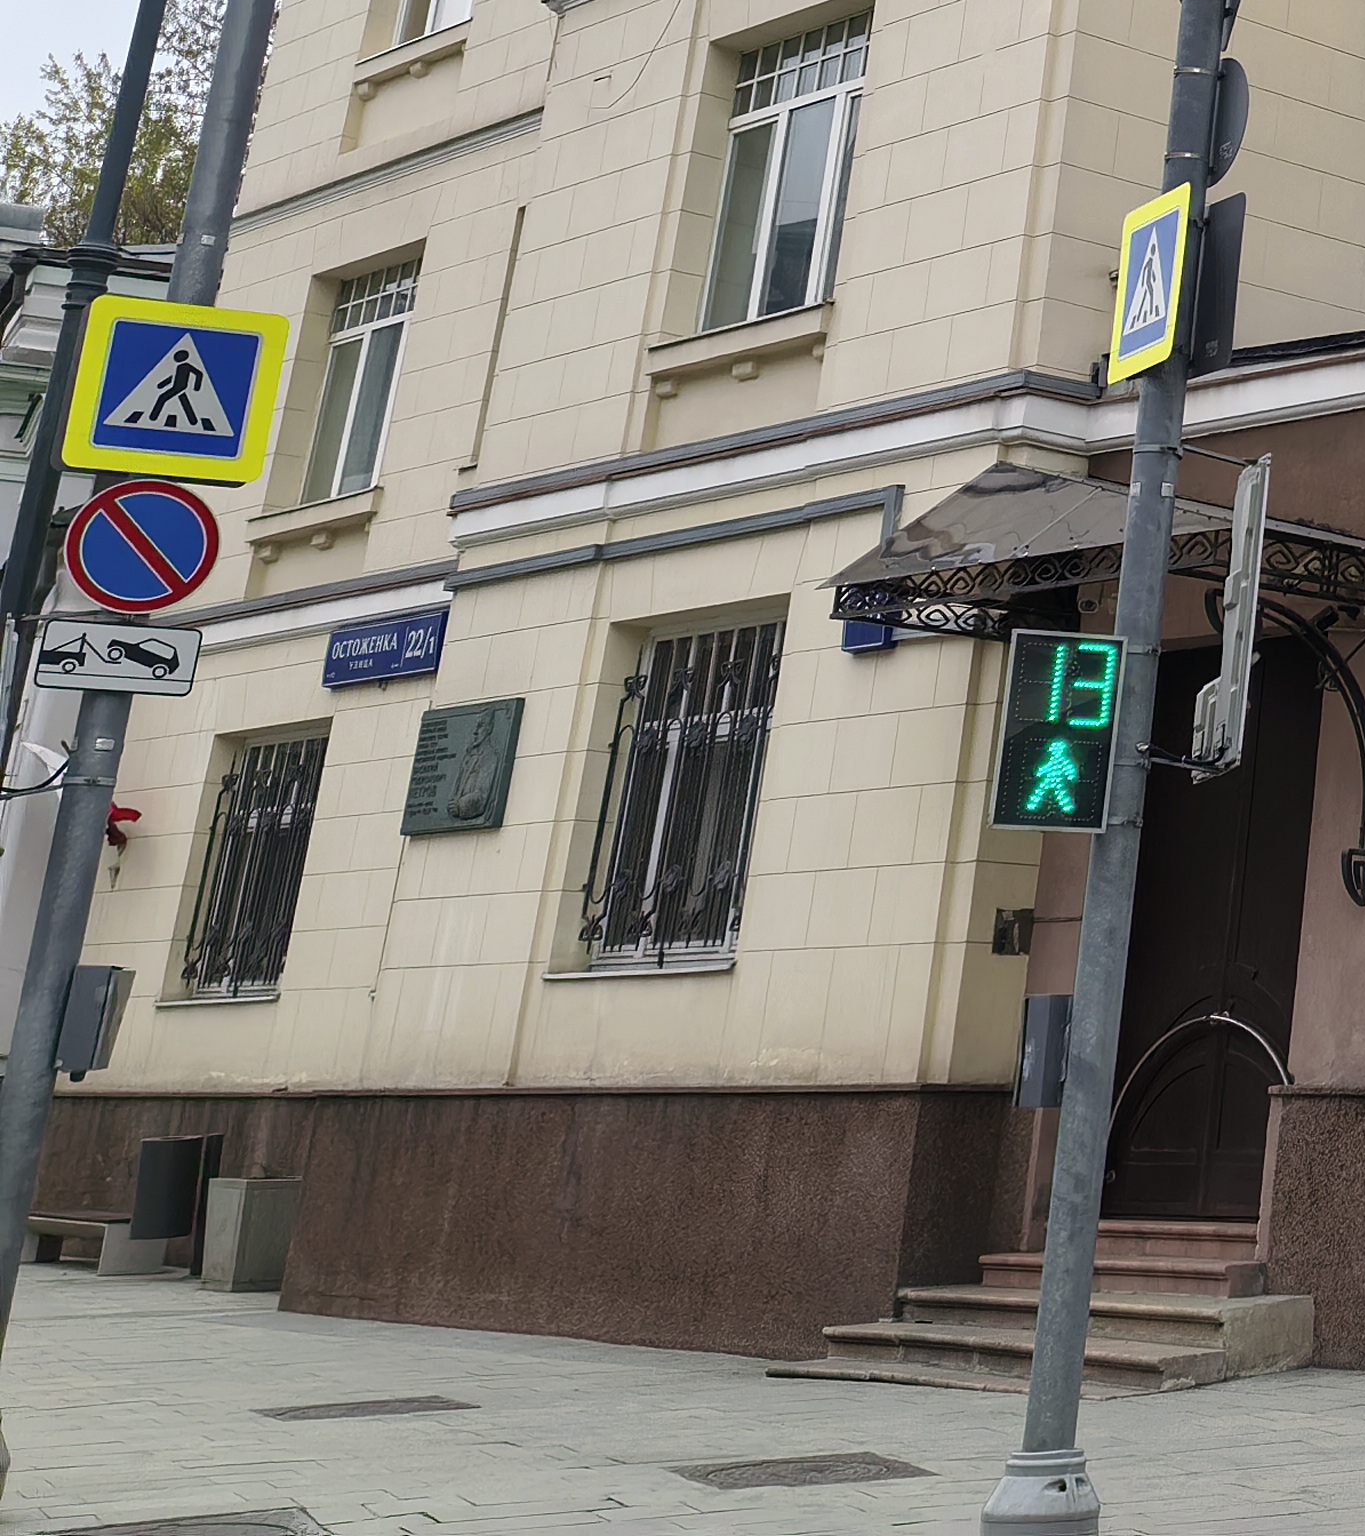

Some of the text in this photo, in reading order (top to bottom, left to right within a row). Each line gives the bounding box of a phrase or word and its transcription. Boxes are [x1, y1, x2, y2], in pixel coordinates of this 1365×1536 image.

[331, 626, 435, 660] ОСТОЖЕНКА 22/1
[1047, 642, 1118, 730] 13
